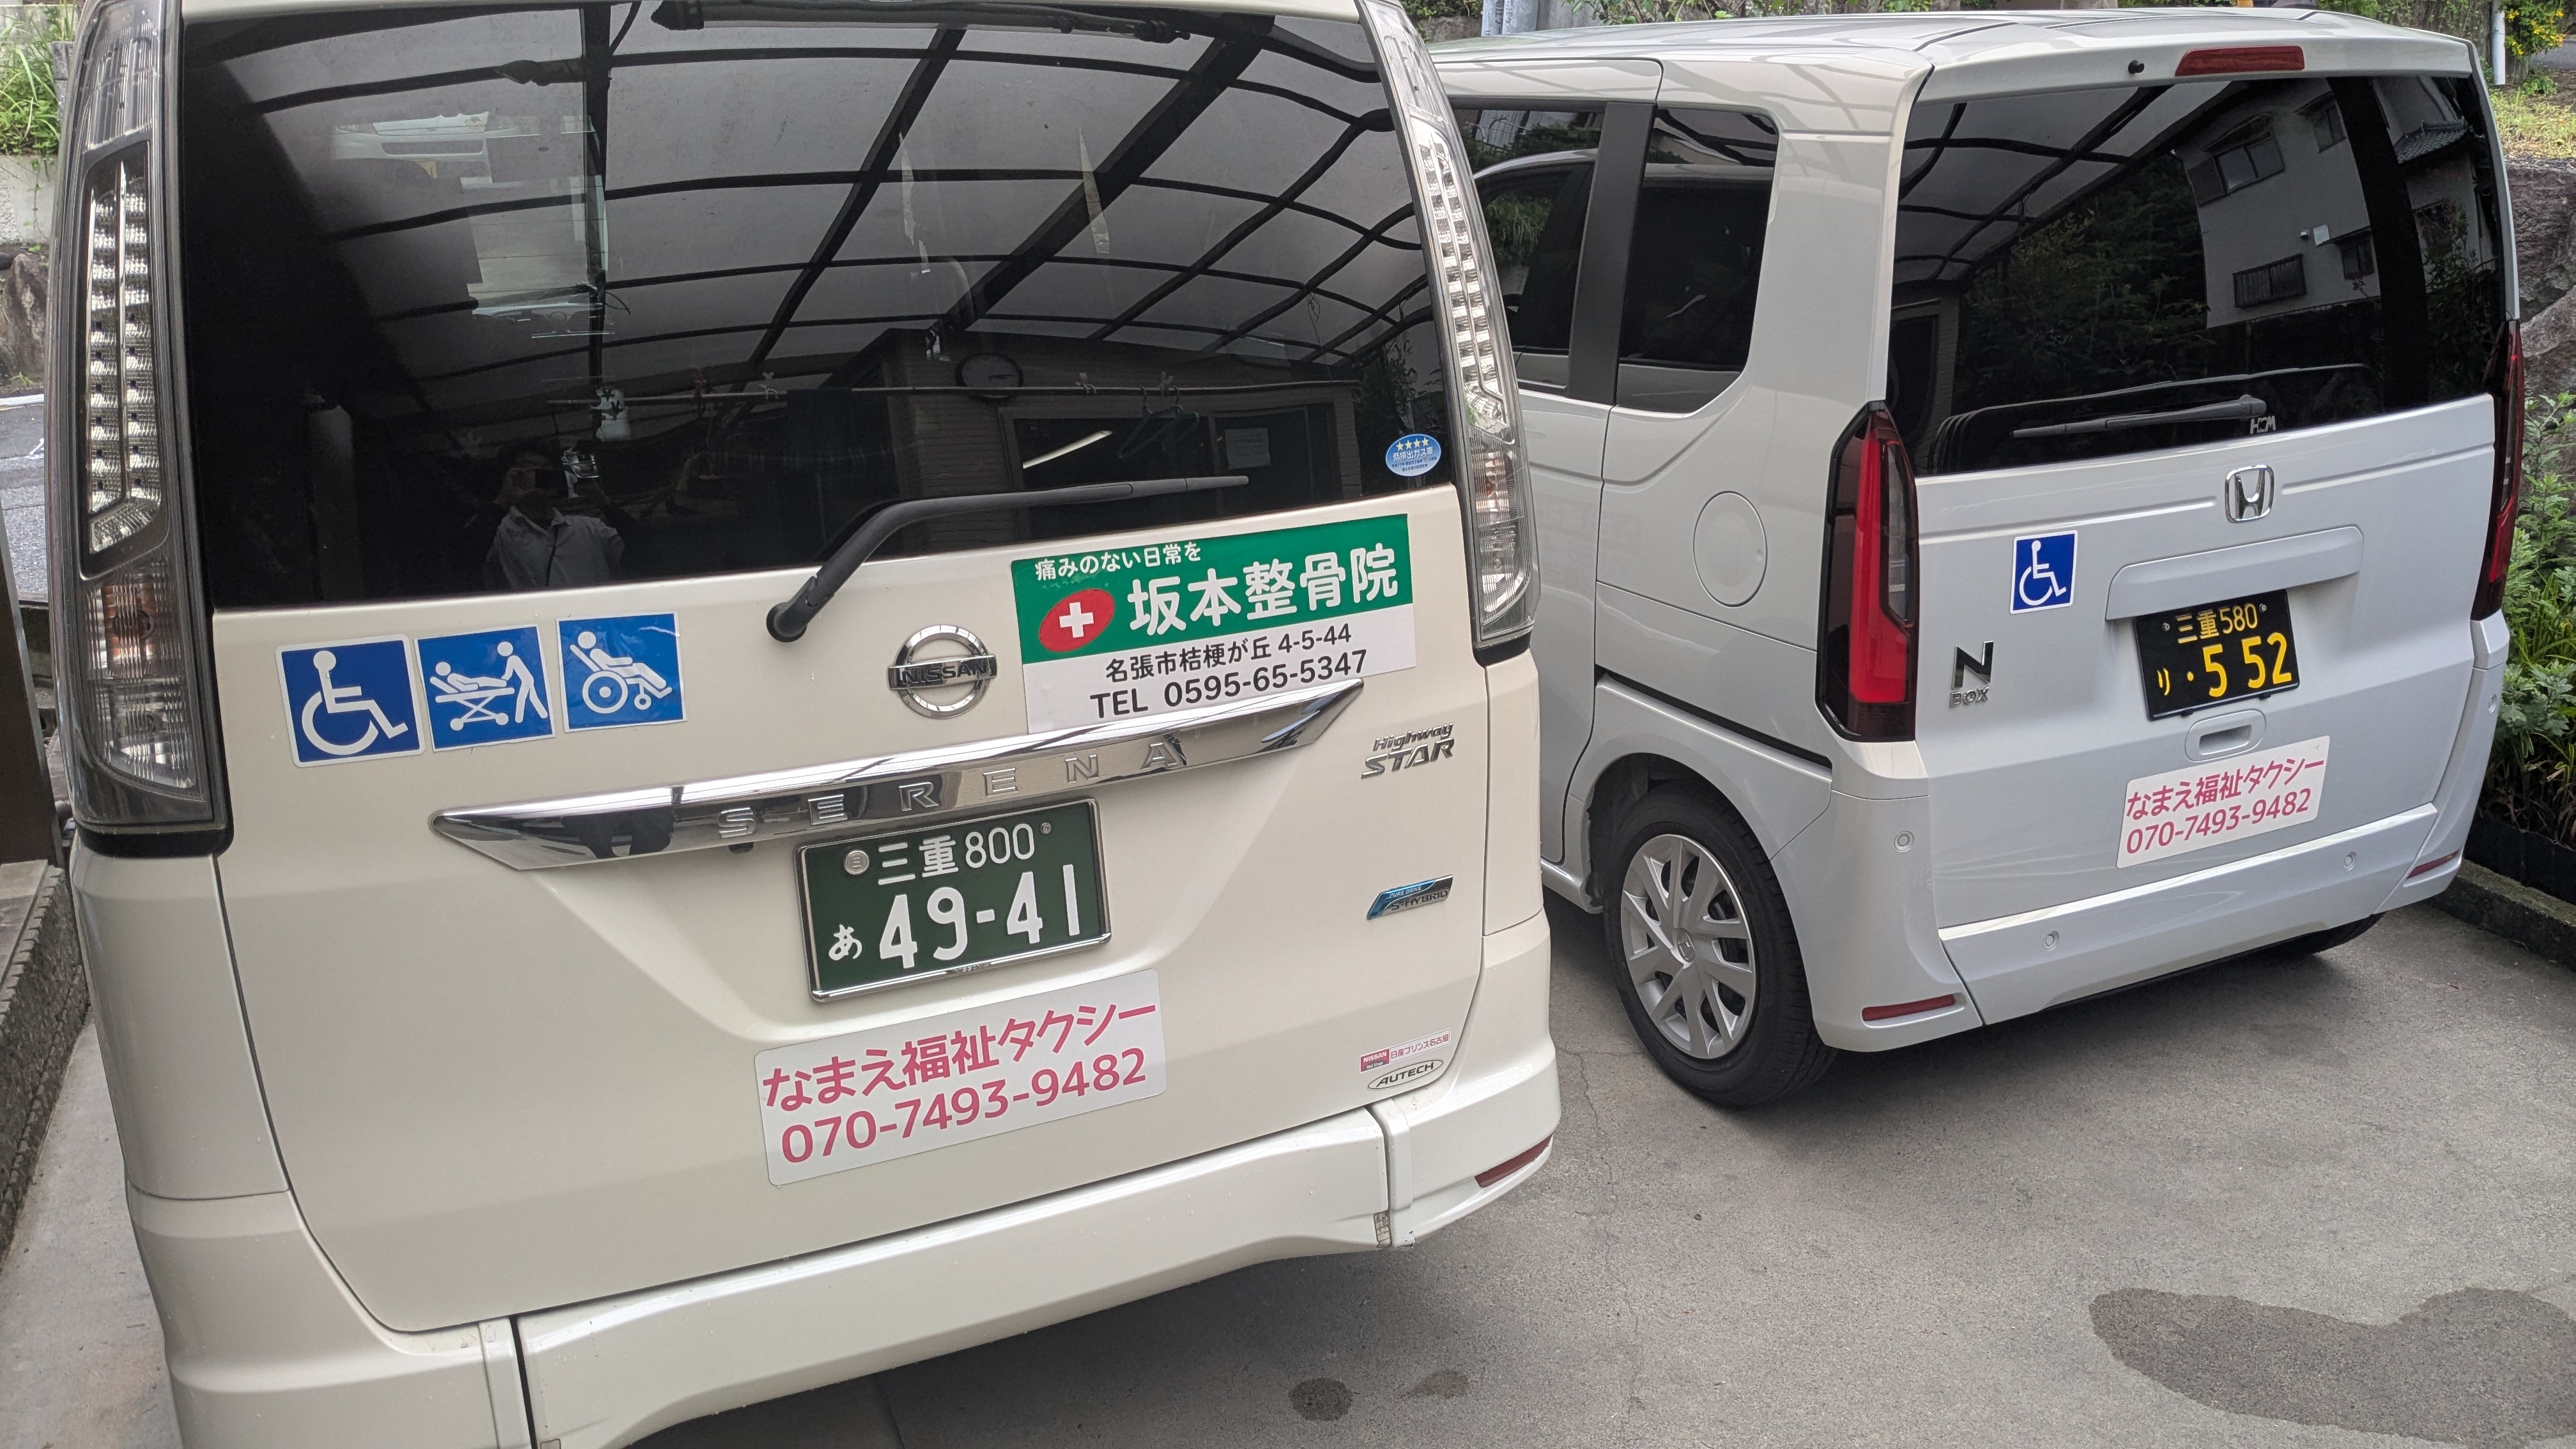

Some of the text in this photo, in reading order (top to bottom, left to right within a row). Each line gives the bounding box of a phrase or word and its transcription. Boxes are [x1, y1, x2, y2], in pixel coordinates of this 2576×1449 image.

[1393, 447, 1433, 462] 低排出ガス車
[1034, 542, 1202, 581] 痛みのない日常を
[1127, 542, 1399, 637] 坂本整骨院
[901, 662, 988, 684] NISSAN
[1105, 624, 1353, 683] 名張市桔梗が丘 4-5-44
[1951, 640, 1995, 689] N
[1090, 649, 1367, 719] TEL 0595-65-5347
[1949, 686, 1990, 708] BOX
[1361, 737, 1455, 779] STAR
[1372, 722, 1454, 752] Highway
[716, 740, 1182, 838] SERENA
[2126, 758, 2324, 820] なまえ福祉タクシー
[2126, 788, 2312, 854] 070-7493-9482
[1391, 890, 1449, 911] S-HYBRID
[1406, 885, 1423, 895] DRIVE
[829, 864, 1080, 969] あ 49-41
[763, 1004, 1157, 1112] なまえ福祉タクシー
[1363, 1051, 1387, 1063] NISSAN
[1390, 1034, 1449, 1059] 日産プリンス名古屋
[1376, 1061, 1434, 1088] AUTECH
[781, 1046, 1147, 1164] 070-7493-9482
